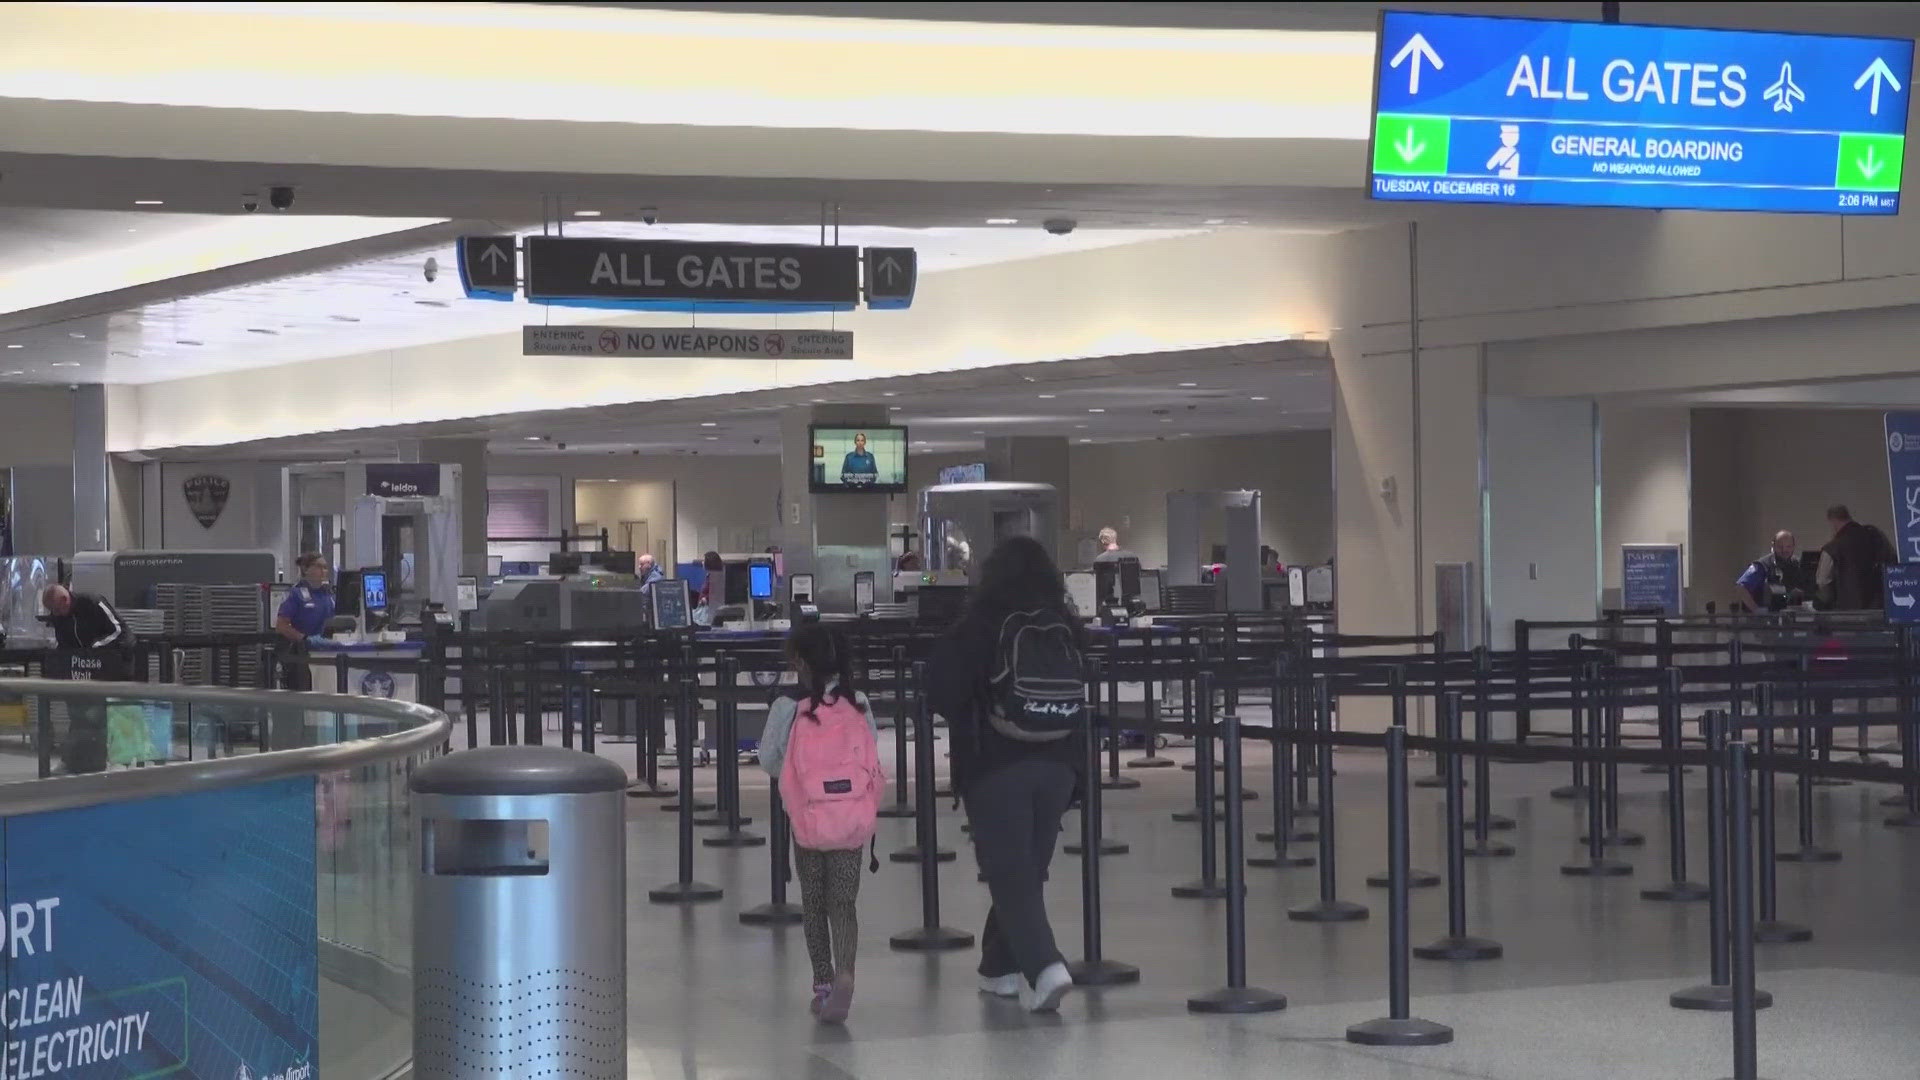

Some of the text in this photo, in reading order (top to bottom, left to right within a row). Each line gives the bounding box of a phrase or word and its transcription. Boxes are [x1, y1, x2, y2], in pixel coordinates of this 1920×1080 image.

[1506, 55, 1747, 108] ALL GATES
[1551, 135, 1743, 162] GENERAL BOARDING
[1592, 161, 1702, 177] NO WEAPONS ALLOWED
[1374, 179, 1516, 196] TUESDAY, DECEMBER 16
[1838, 194, 1860, 207] 2:06
[1862, 194, 1878, 207] PM
[590, 252, 802, 290] ALL GATES
[533, 330, 585, 341] ENTERING
[626, 333, 760, 352] NO WEAPONS
[71, 655, 103, 669] Please
[0, 896, 60, 959] RT
[0, 975, 84, 1031] CLEAN
[0, 1010, 150, 1080] ELECTRICITY
